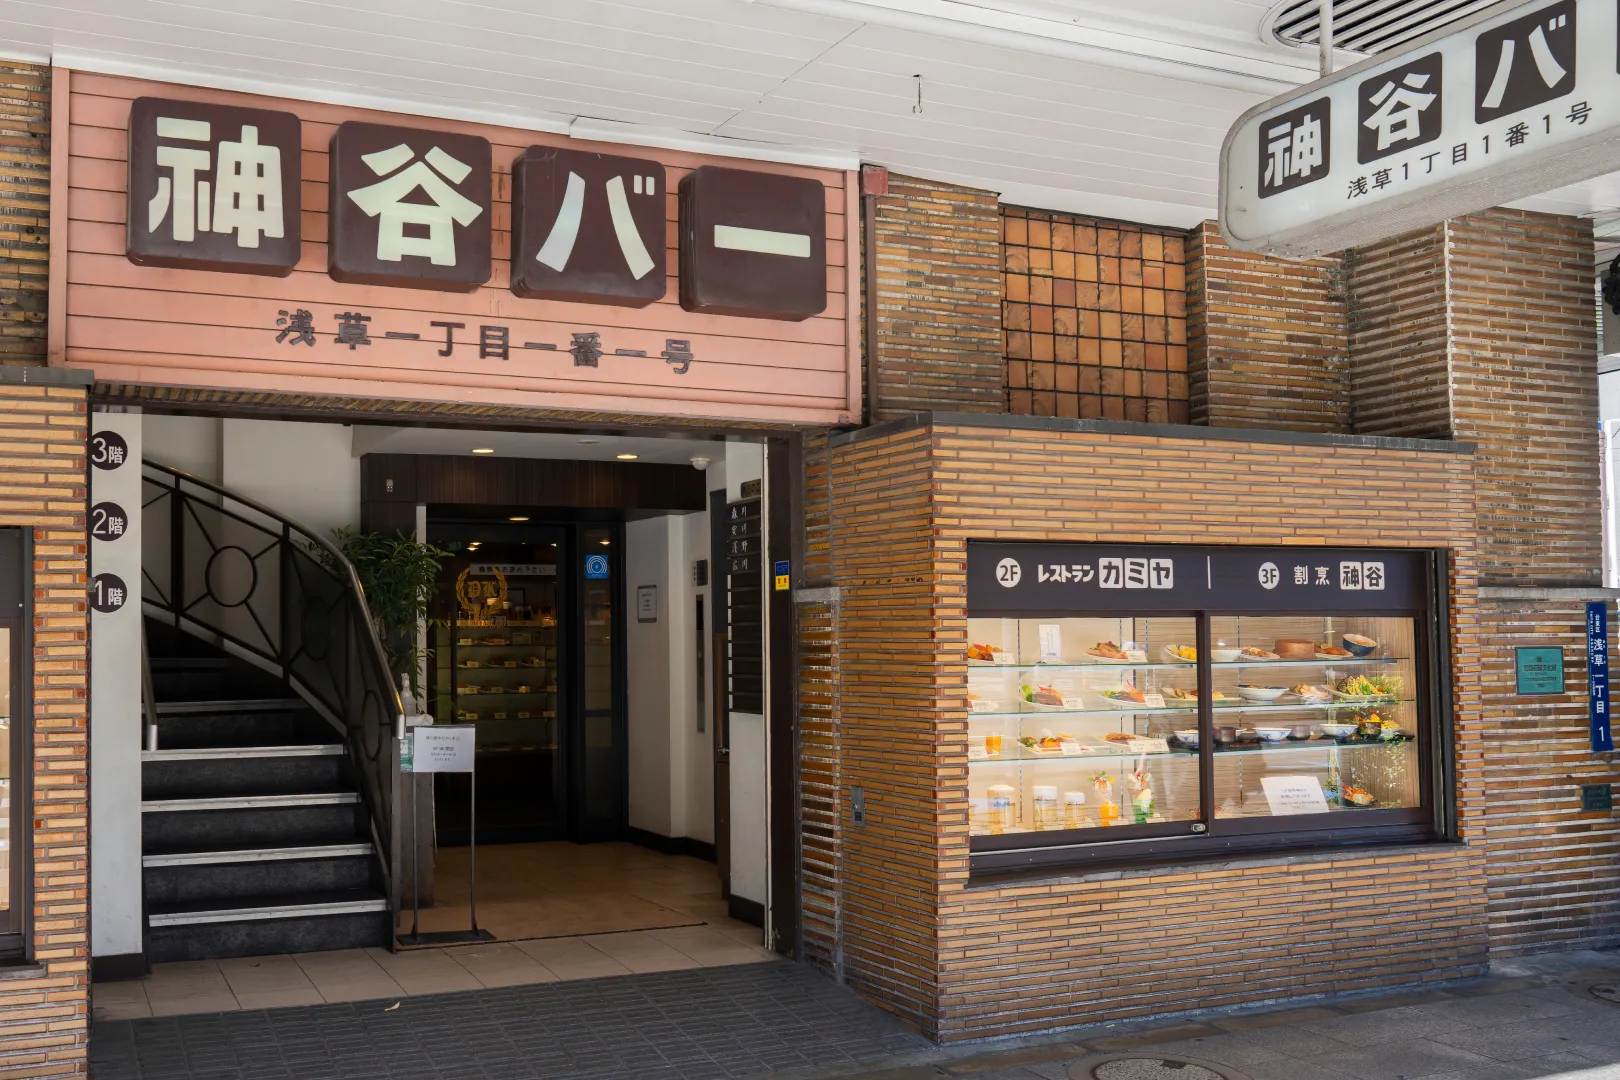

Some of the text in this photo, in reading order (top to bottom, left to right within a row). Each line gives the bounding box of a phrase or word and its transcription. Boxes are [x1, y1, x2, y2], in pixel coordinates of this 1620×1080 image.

[1346, 100, 1593, 200] 浅草1丁目1番1号
[147, 115, 813, 282] 神谷バー
[275, 308, 695, 374] 浅草一丁目一番一号
[91, 437, 124, 464] 3階
[92, 508, 123, 535] 2階
[998, 565, 1018, 582] 2F
[1101, 560, 1172, 586] カミヤ
[1261, 564, 1384, 588] 3F 割烹 神谷
[94, 580, 123, 606] 1階
[1593, 637, 1605, 714] 浅草一丁目
